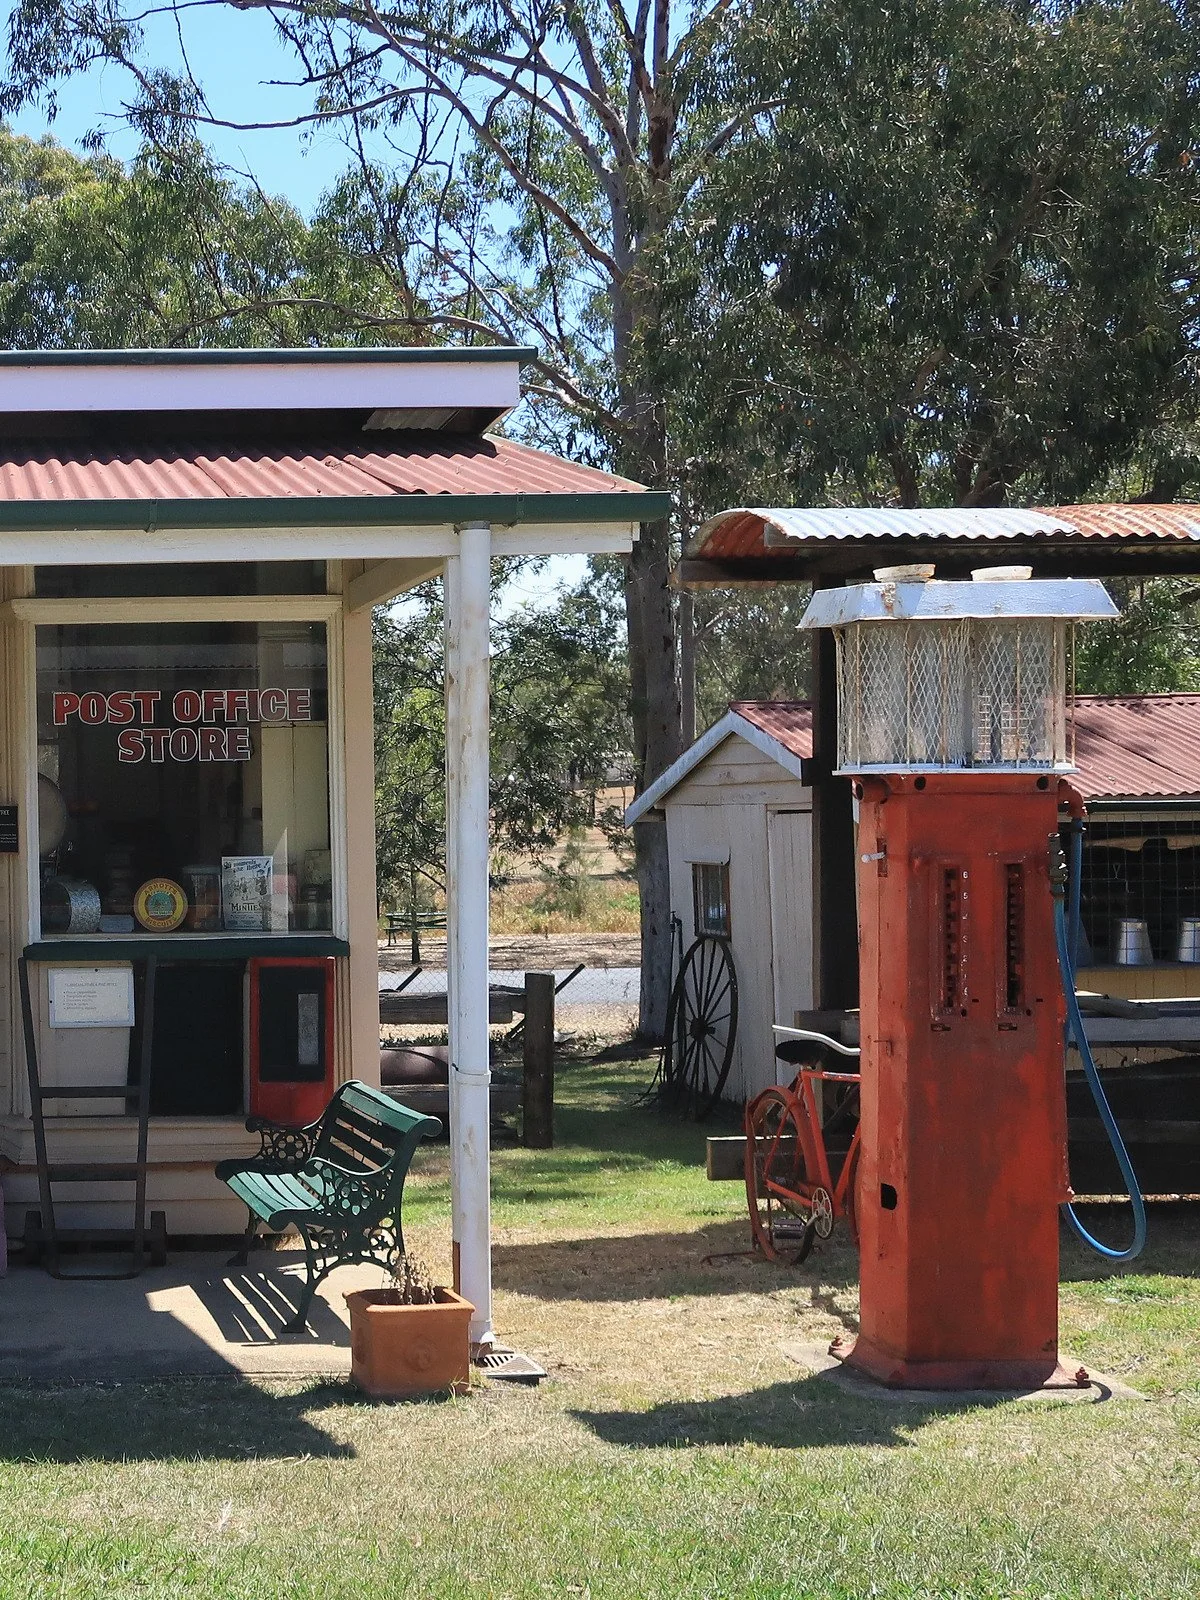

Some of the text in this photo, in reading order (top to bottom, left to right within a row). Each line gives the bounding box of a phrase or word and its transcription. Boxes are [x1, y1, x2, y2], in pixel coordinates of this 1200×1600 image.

[52, 688, 311, 726] POST OFFICE
[117, 726, 251, 763] STORE
[962, 871, 968, 879] 6
